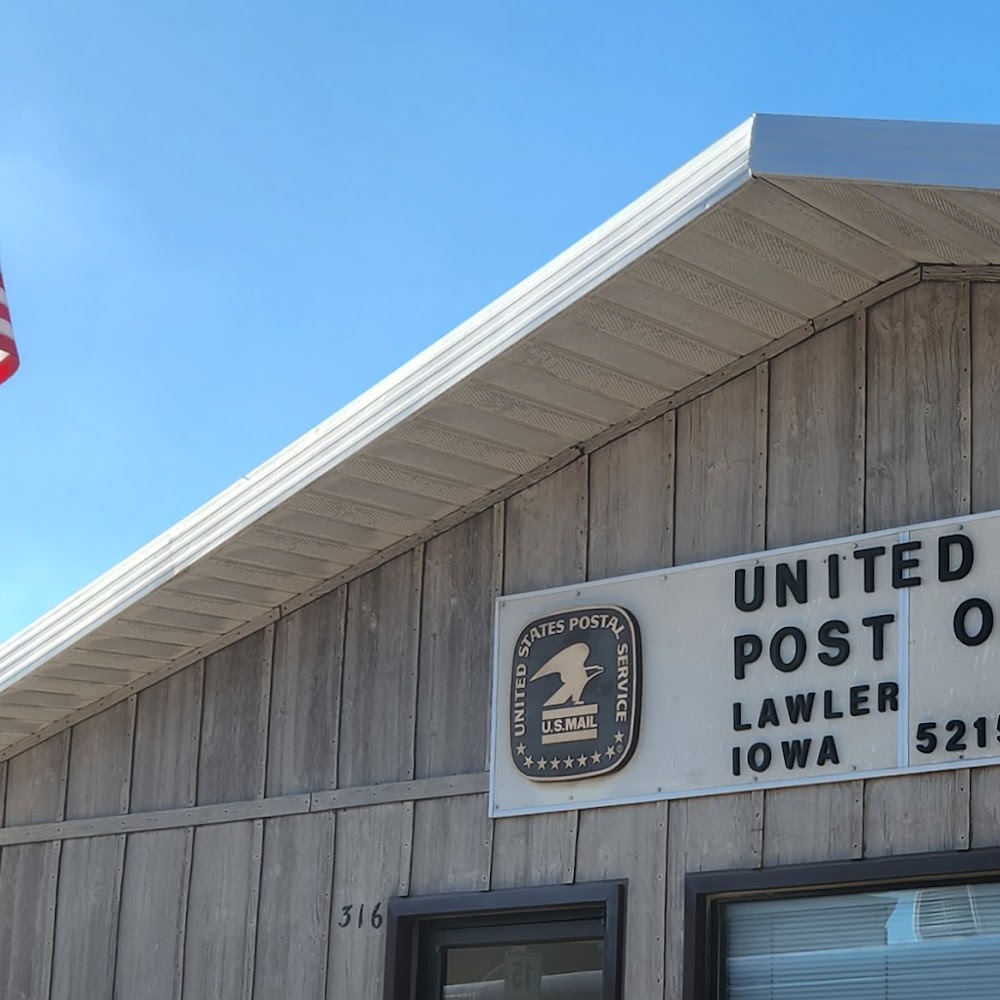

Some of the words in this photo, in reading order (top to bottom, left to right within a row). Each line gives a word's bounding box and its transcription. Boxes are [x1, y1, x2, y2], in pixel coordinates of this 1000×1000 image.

[734, 534, 974, 612] UNITED
[518, 619, 566, 658] STATES
[569, 614, 626, 640] POSTAL
[733, 614, 895, 680] POST
[514, 663, 527, 737] UNITED
[615, 643, 629, 723] SERVICE
[733, 682, 899, 731] LAWLER
[732, 735, 840, 776] IOWA
[338, 902, 383, 929] 316
